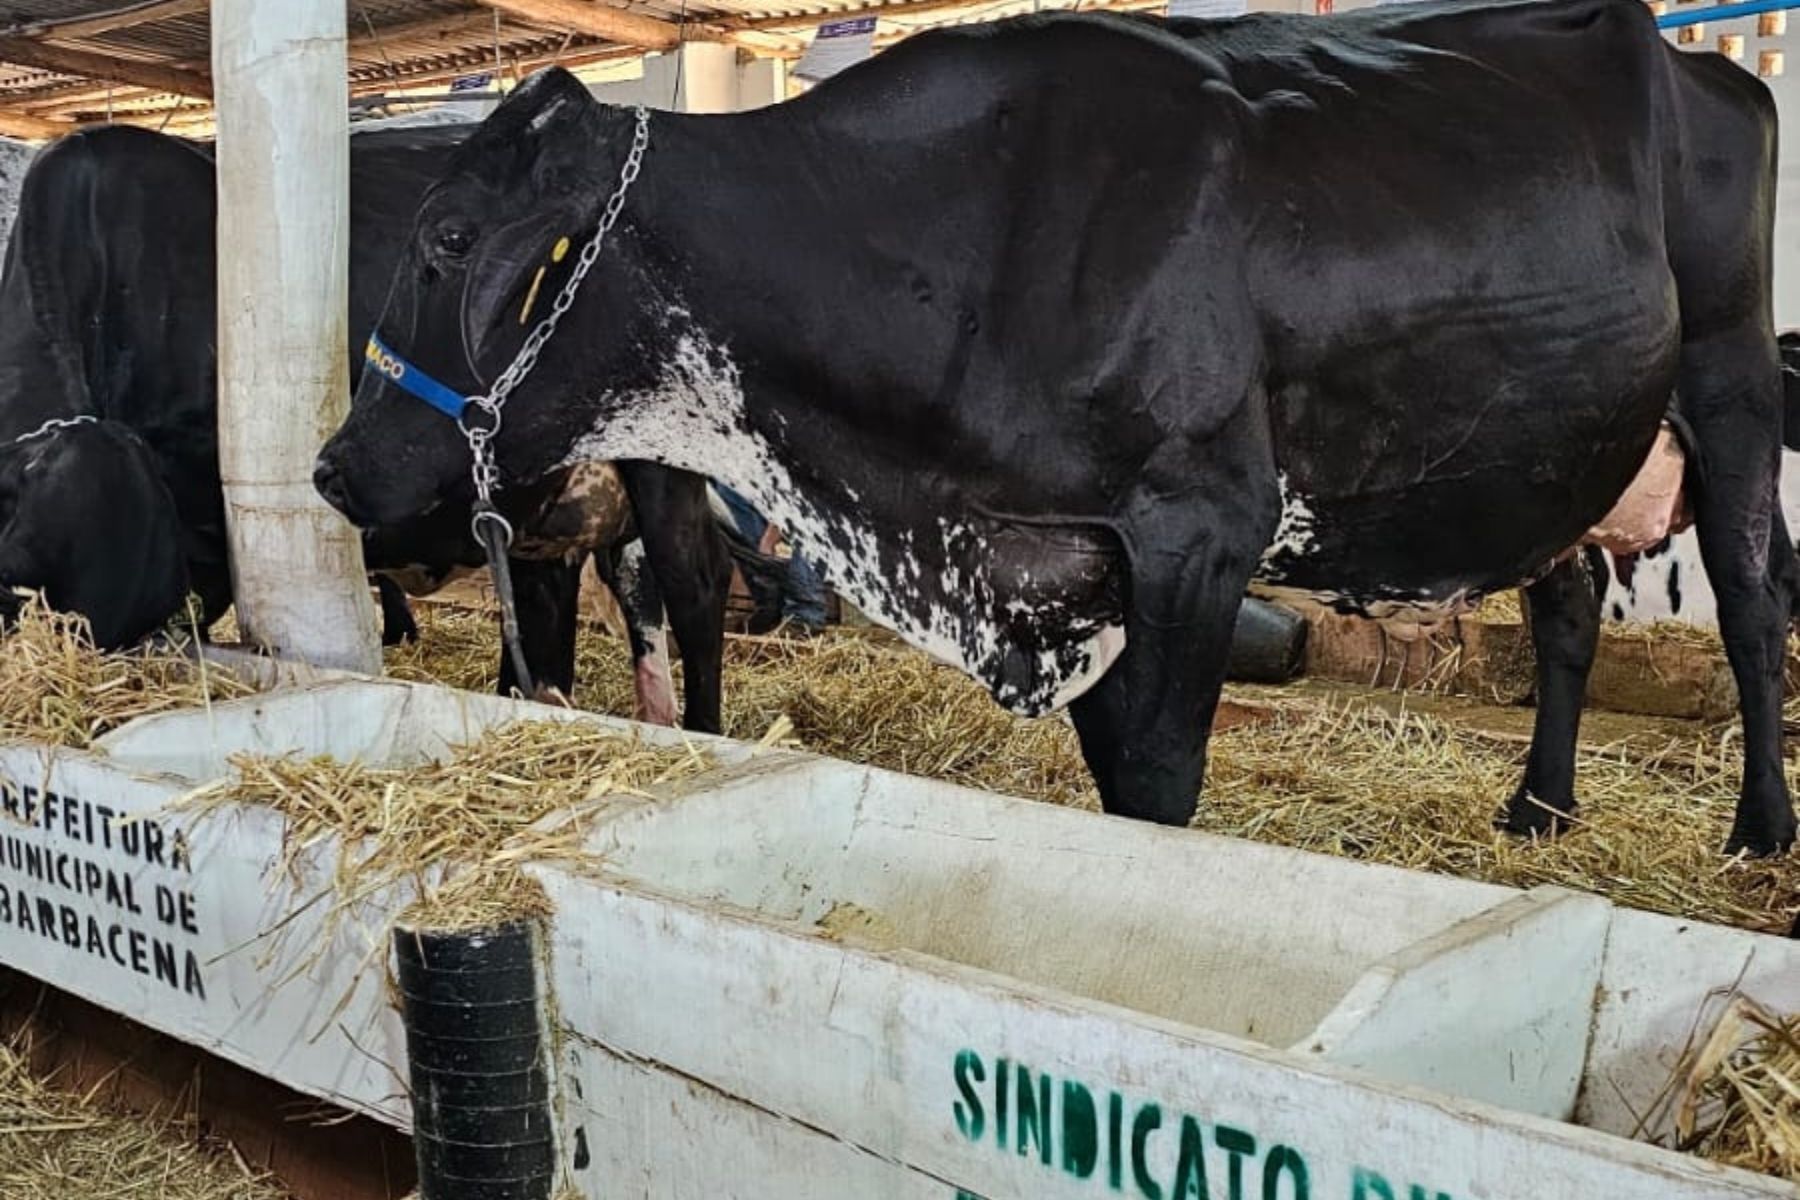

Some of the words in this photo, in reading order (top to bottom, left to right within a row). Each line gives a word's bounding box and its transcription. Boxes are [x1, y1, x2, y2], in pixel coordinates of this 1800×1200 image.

[0, 834, 142, 915] UNICIPAL
[156, 884, 199, 935] DE
[0, 882, 206, 1001] BARBACENA
